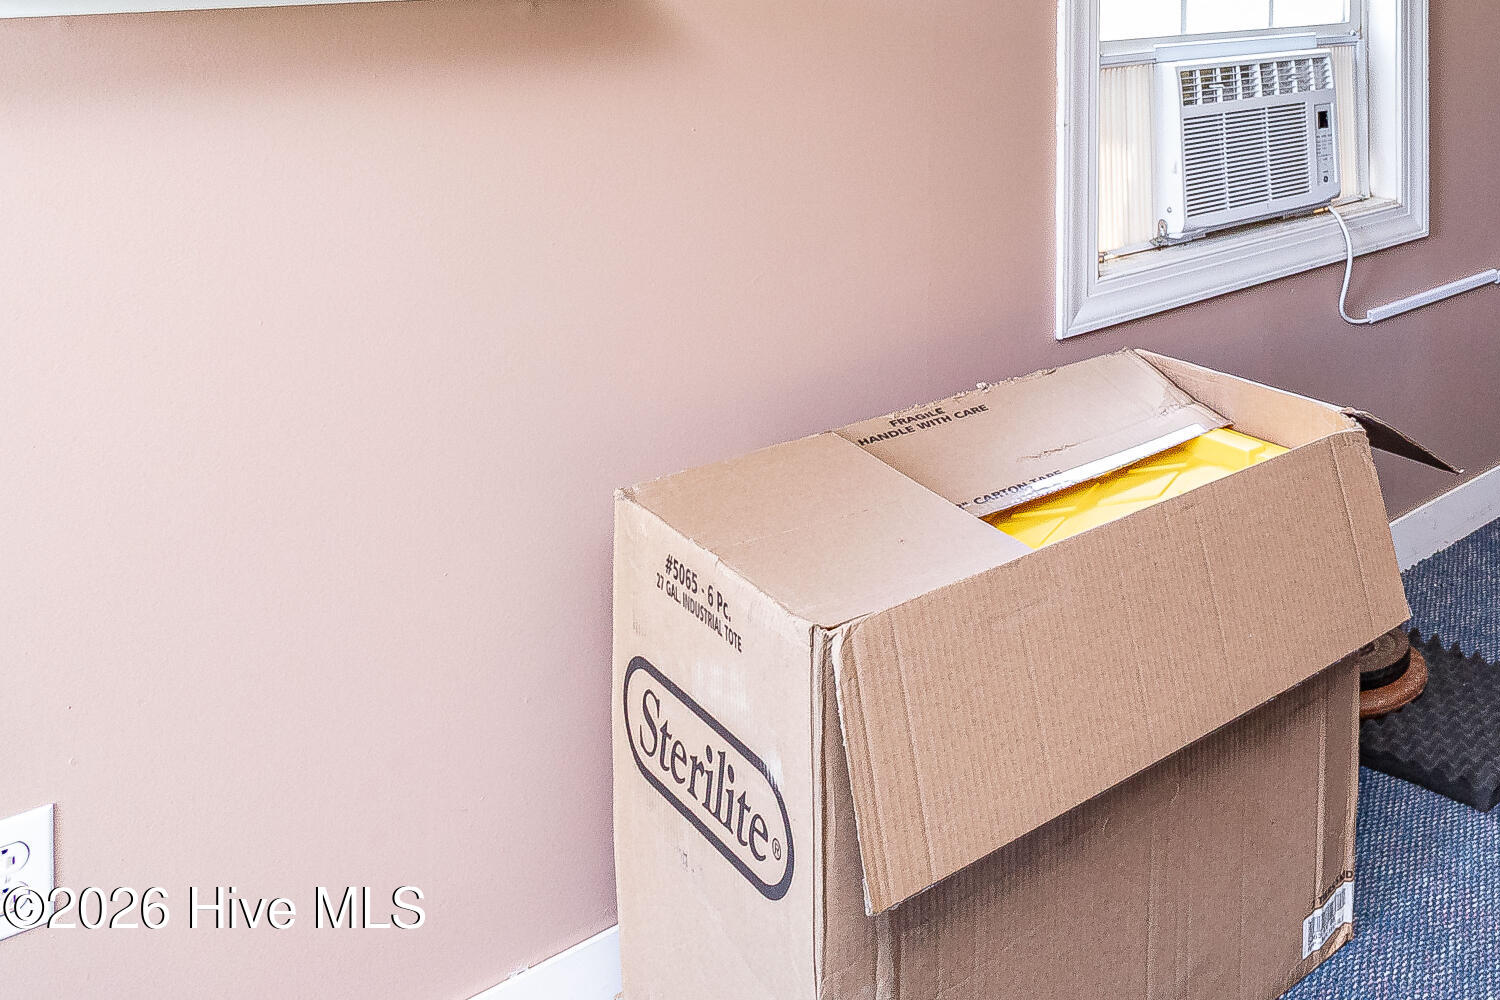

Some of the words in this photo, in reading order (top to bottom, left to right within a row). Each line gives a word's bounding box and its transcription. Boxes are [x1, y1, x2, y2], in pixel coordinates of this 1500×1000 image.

[858, 425, 916, 446] HANDLE
[916, 415, 952, 430] WITH
[954, 404, 989, 419] CARE
[889, 407, 945, 427] FRAGILE
[973, 481, 1028, 504] CARTON
[665, 553, 698, 594] #5065
[707, 585, 714, 607] 6
[656, 572, 664, 590] 27
[682, 592, 722, 637] INDUSTRIAL
[724, 624, 742, 653] TOTE
[640, 689, 768, 861] Sterilite
